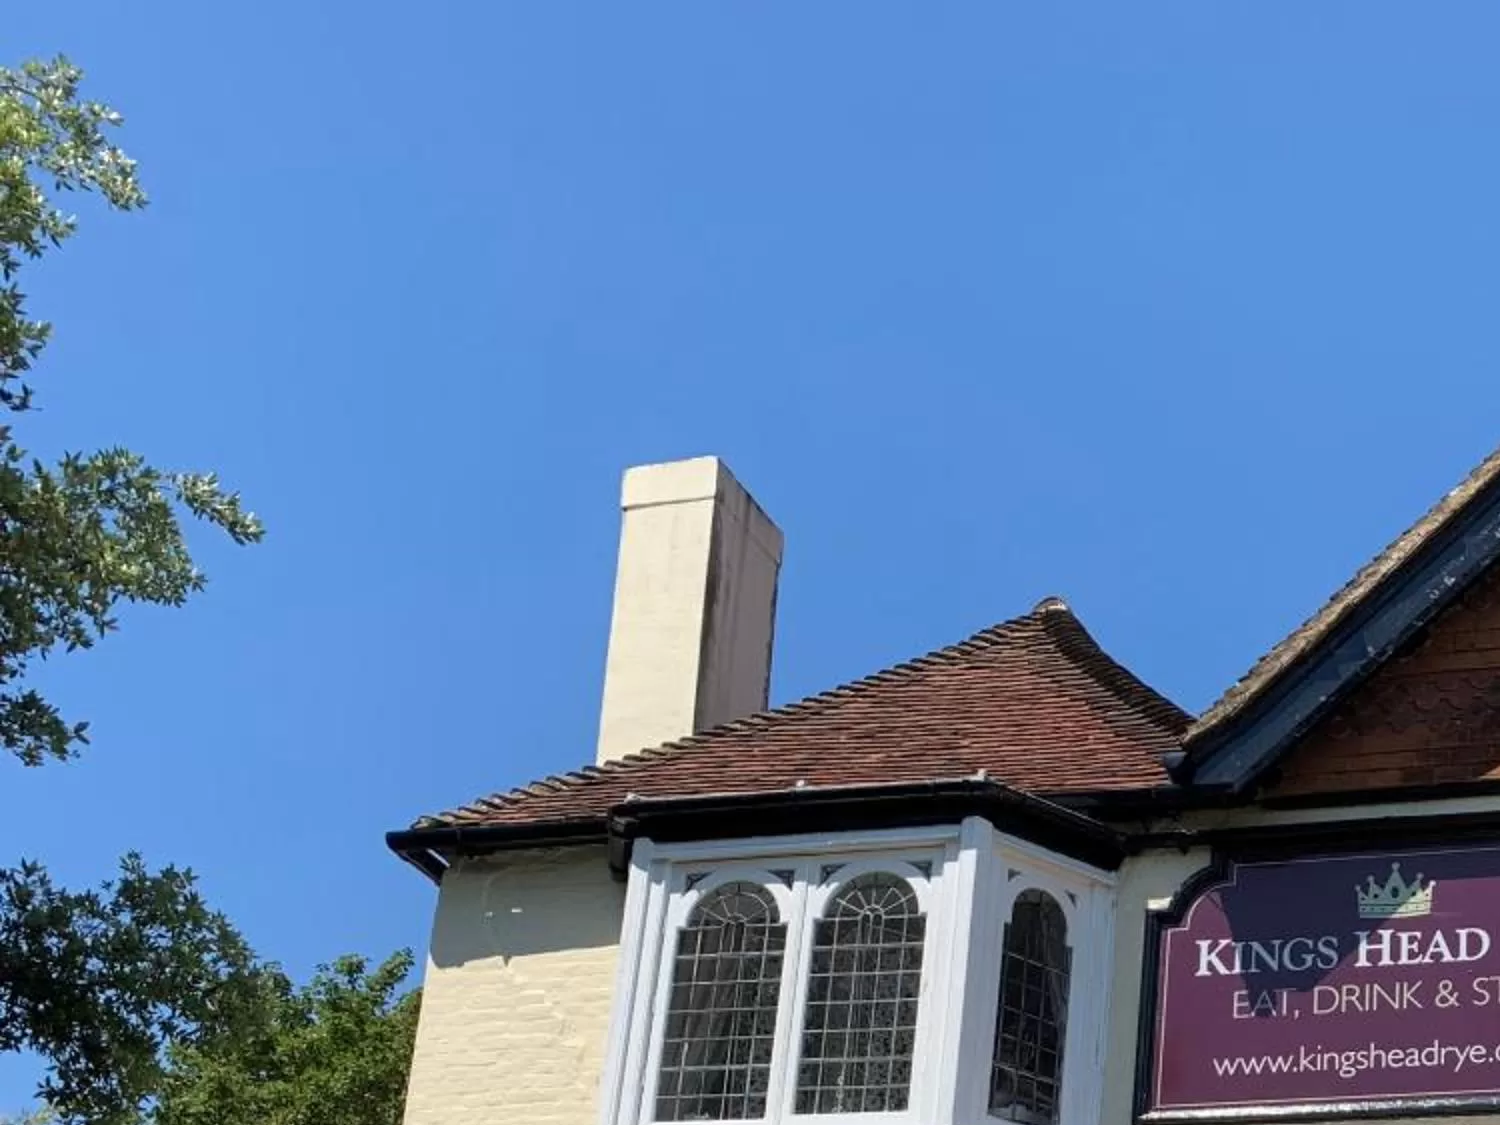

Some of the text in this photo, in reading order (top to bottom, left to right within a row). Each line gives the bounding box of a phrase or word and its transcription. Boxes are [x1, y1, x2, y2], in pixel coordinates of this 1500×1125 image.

[1194, 935, 1340, 977] KINGS
[1353, 927, 1491, 968] HEAD
[1232, 988, 1301, 1021] EAT,
[1313, 979, 1423, 1016] DRINK
[1435, 979, 1460, 1008] &
